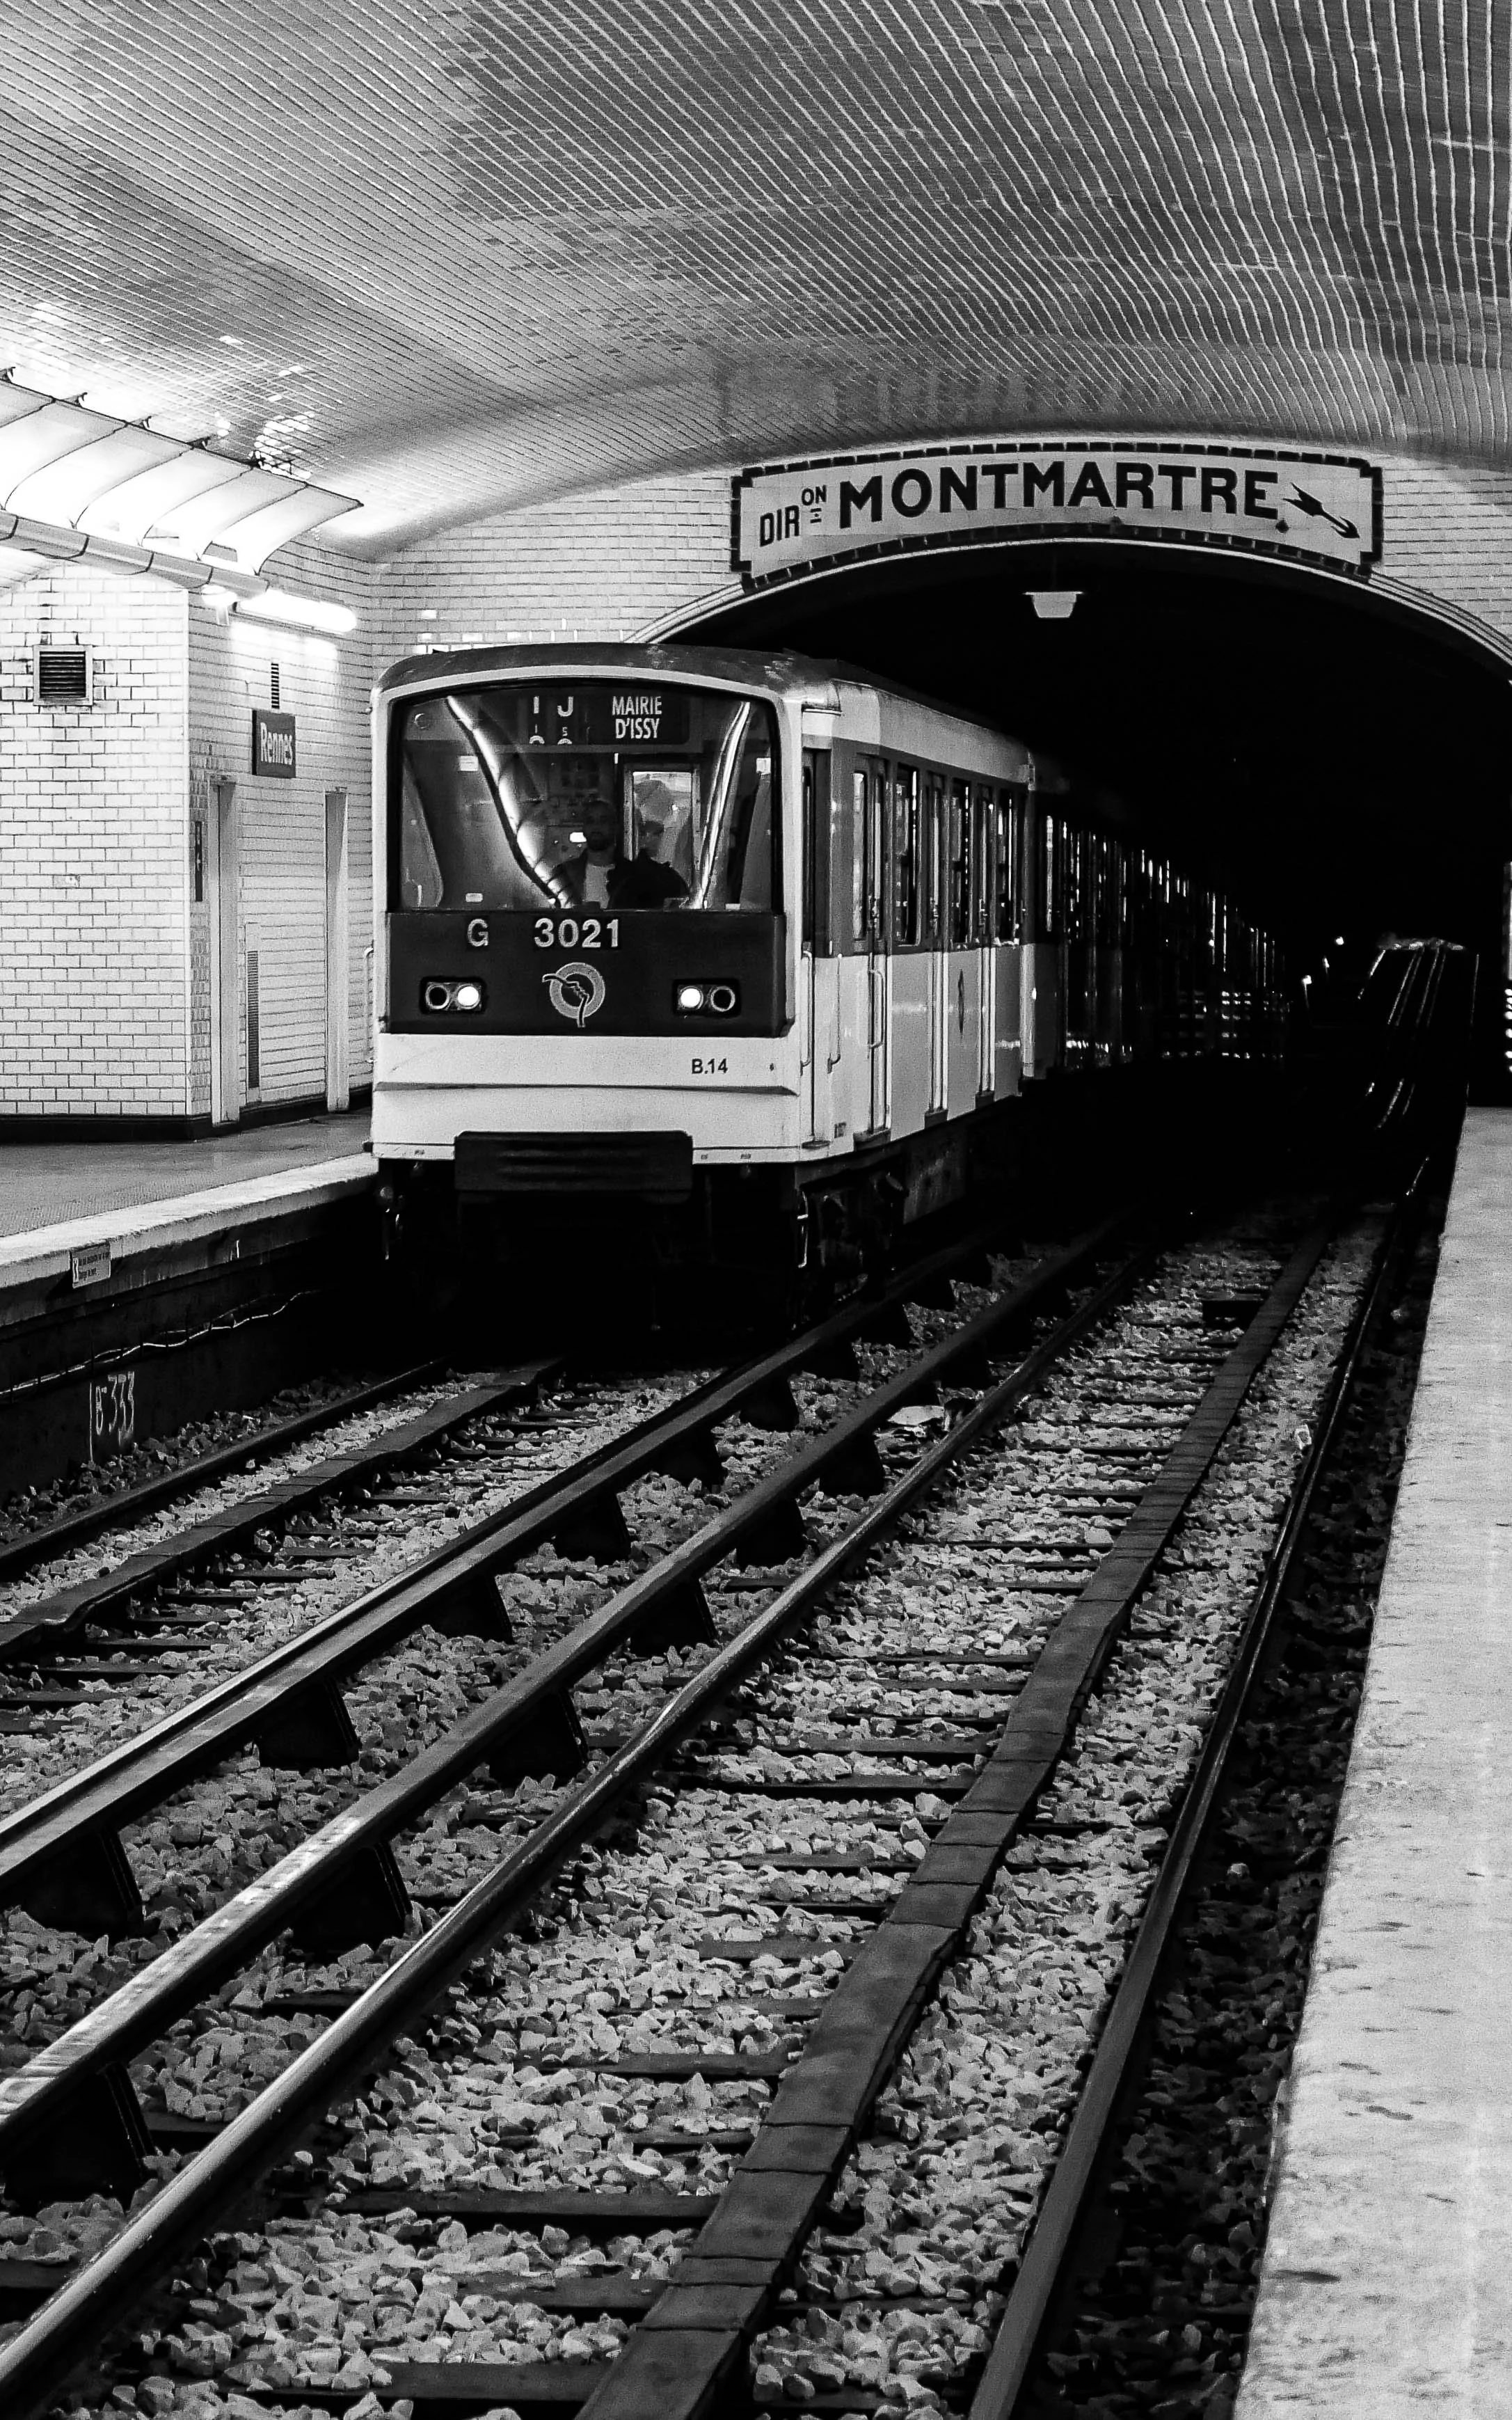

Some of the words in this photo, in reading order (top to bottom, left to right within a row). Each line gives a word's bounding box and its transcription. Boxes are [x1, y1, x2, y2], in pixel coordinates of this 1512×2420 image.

[839, 461, 1279, 529] MONTMARTRE
[612, 695, 662, 715] MAIRIE
[616, 718, 660, 739] D'ISSY
[260, 722, 293, 766] Rennes
[468, 918, 488, 947] G
[534, 917, 619, 948] 3021
[692, 1058, 729, 1075] B.14
